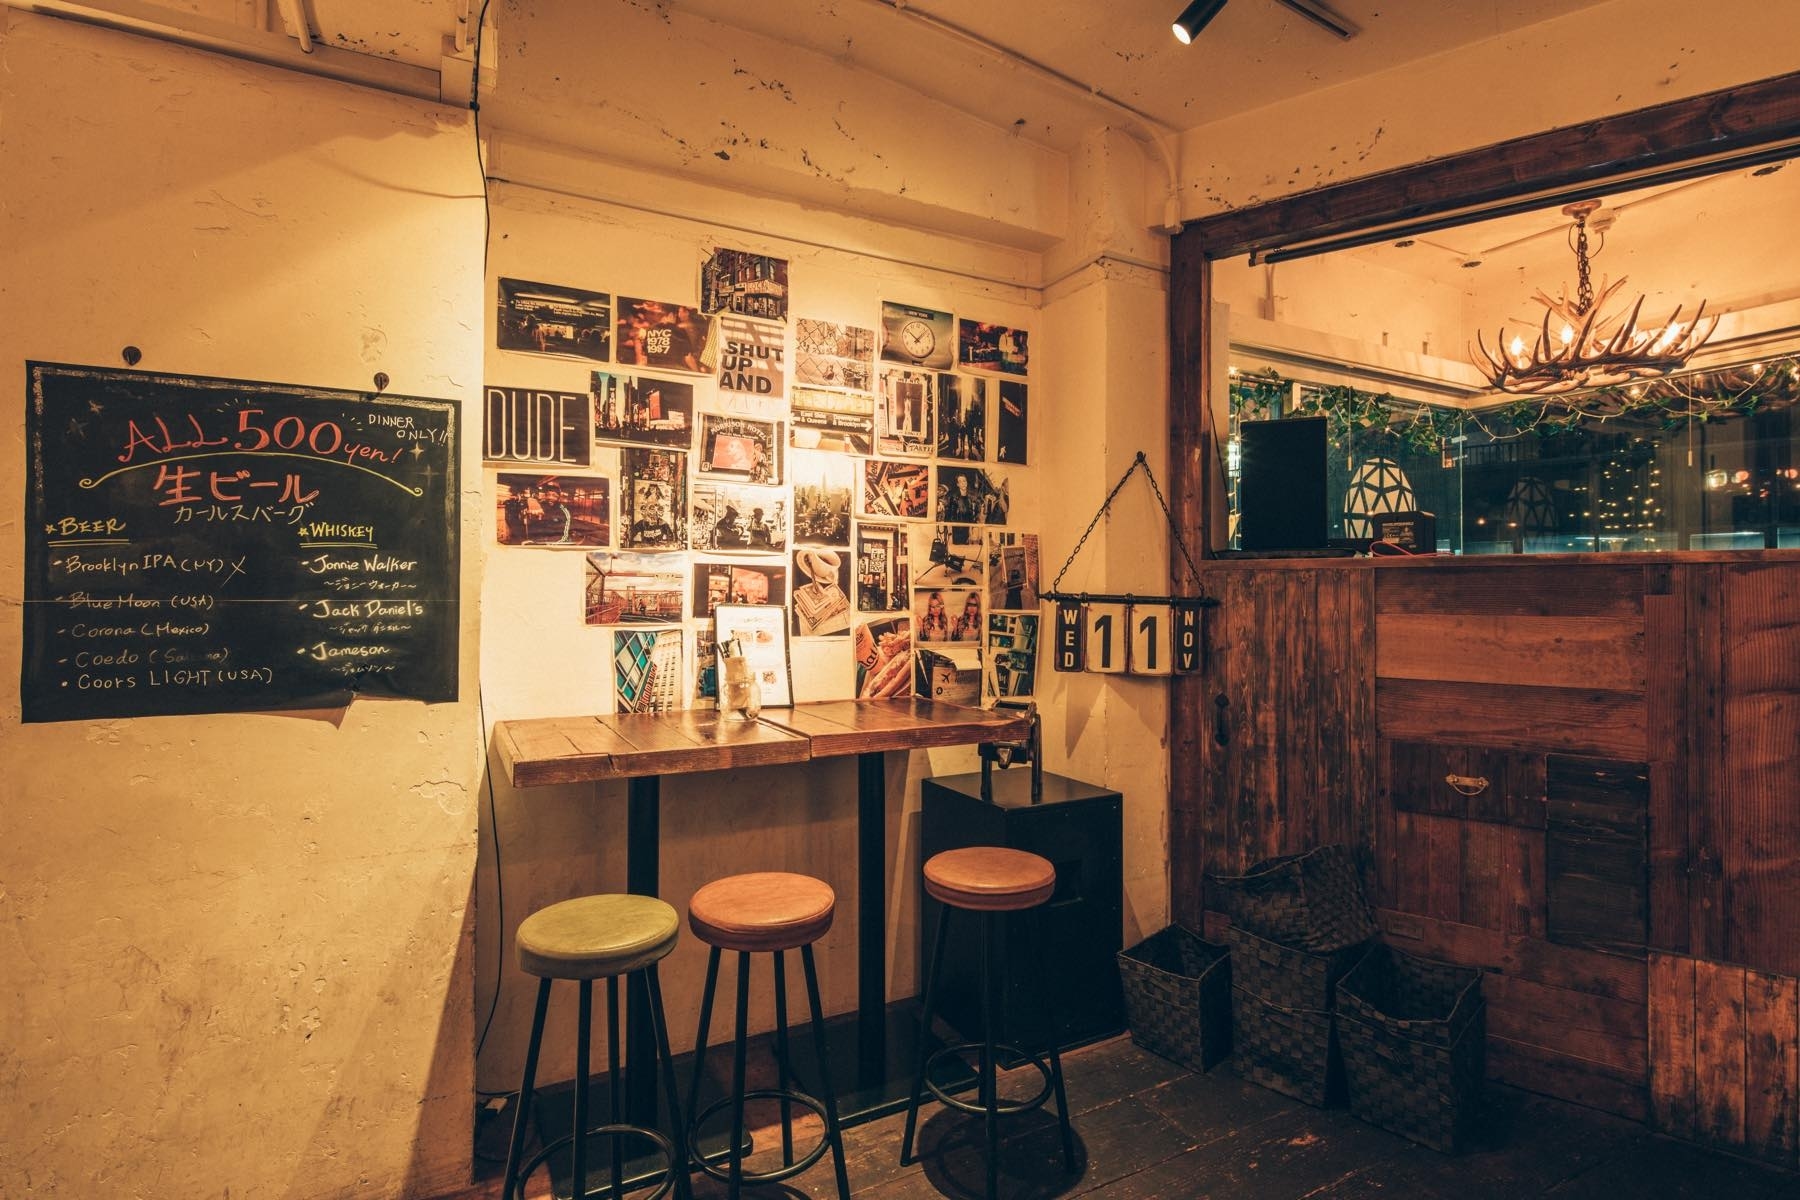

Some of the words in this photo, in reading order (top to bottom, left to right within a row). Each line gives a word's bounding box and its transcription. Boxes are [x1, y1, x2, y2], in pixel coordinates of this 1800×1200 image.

[647, 328, 672, 338] NYC
[647, 337, 671, 345] 1978
[647, 345, 671, 354] 1987
[725, 341, 783, 361] SHUT
[721, 355, 753, 372] UP
[719, 371, 772, 394] AND
[368, 414, 415, 429] DINNER
[487, 389, 577, 463] DUDE
[118, 413, 229, 462] ALL
[234, 409, 342, 455] 500
[153, 465, 320, 505] 生ビール
[174, 502, 315, 525] カールスバーグ
[58, 516, 127, 536] BEER
[309, 522, 374, 542] WHISKEY
[66, 555, 139, 576] Brooklyn
[142, 554, 177, 570] IPA
[180, 558, 224, 573] (NY)
[310, 554, 360, 574] Jonnie
[364, 554, 418, 572] Walker
[69, 591, 111, 609] Blue
[313, 599, 360, 618] Jack
[364, 600, 423, 618] Daniel's
[71, 623, 136, 638] Corona
[140, 621, 209, 637] (Mexico)
[1063, 609, 1079, 668] WED
[1183, 610, 1194, 669] NOV
[75, 649, 140, 668] Coedo
[311, 641, 390, 660] Jameson
[78, 674, 137, 690] Coors
[150, 670, 211, 686] LIGHT
[218, 667, 273, 684] (USA)
